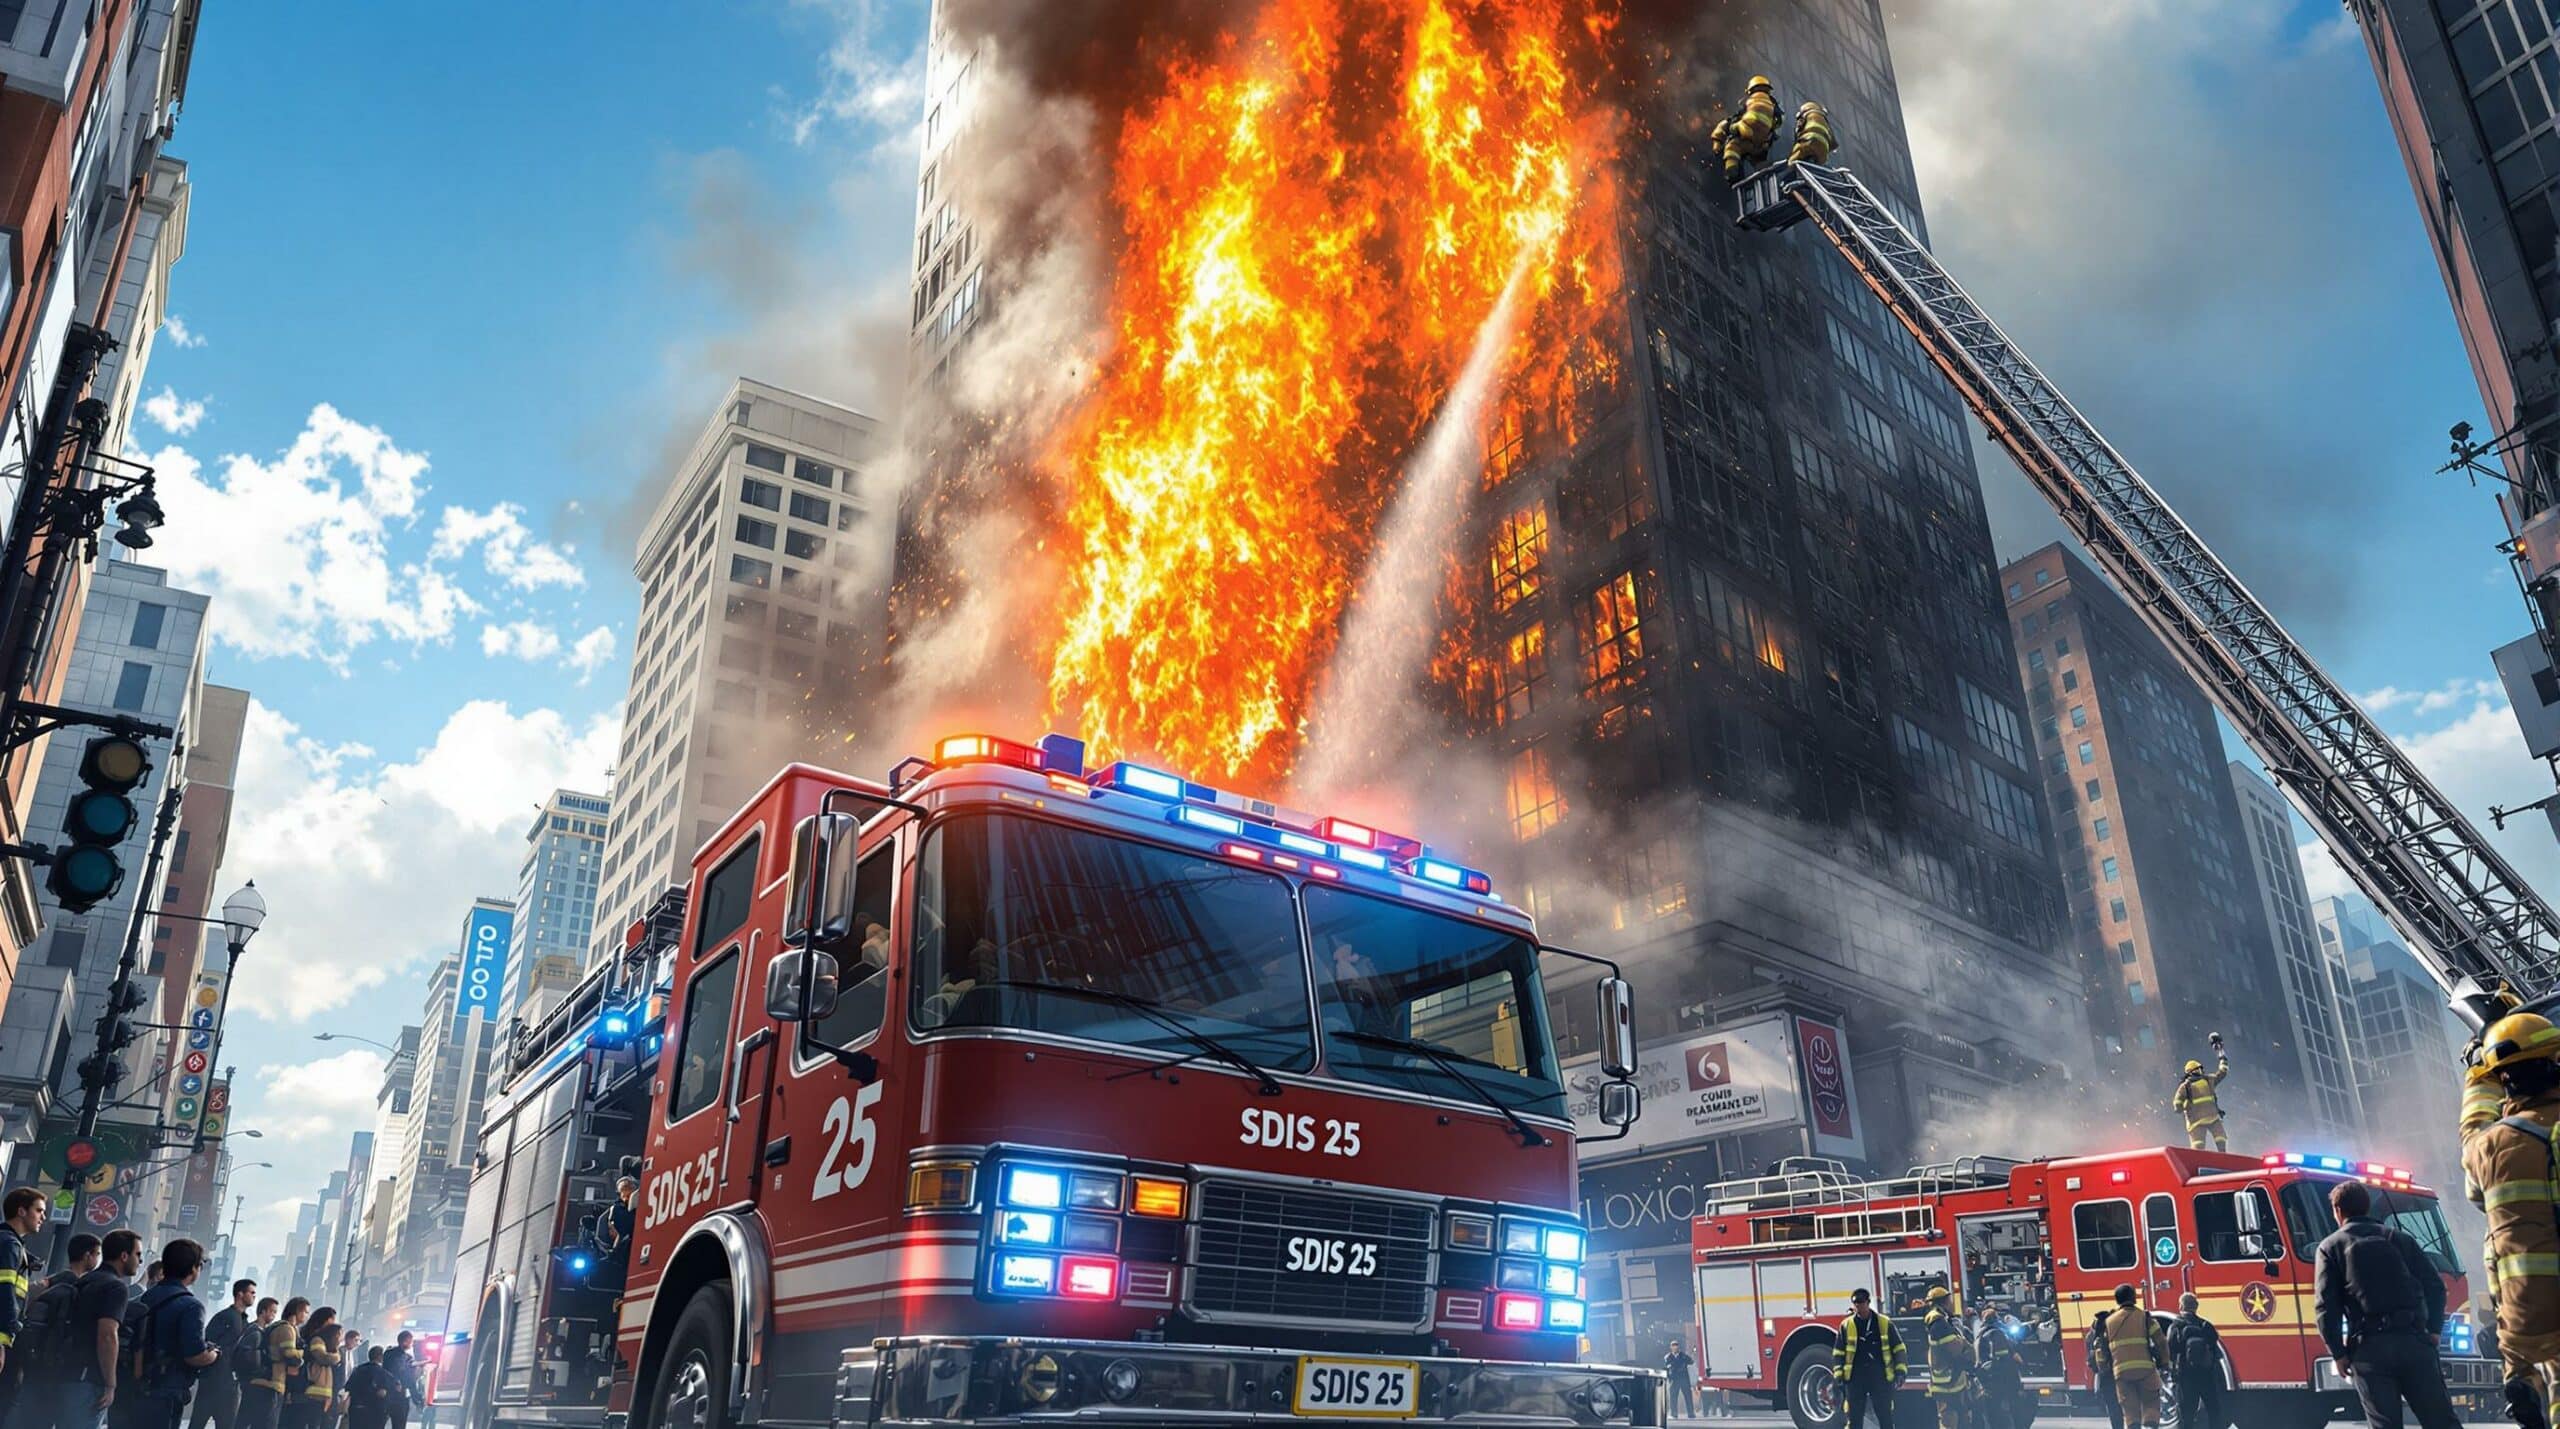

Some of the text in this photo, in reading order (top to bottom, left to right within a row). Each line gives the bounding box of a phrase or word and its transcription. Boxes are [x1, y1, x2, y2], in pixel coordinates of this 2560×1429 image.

[812, 1079, 883, 1202] 25
[1240, 1107, 1361, 1157] SDIS 25
[644, 1146, 719, 1230] SDIS 25
[1286, 1236, 1378, 1277] SDIS 25
[1310, 1367, 1405, 1406] SDIS 25
